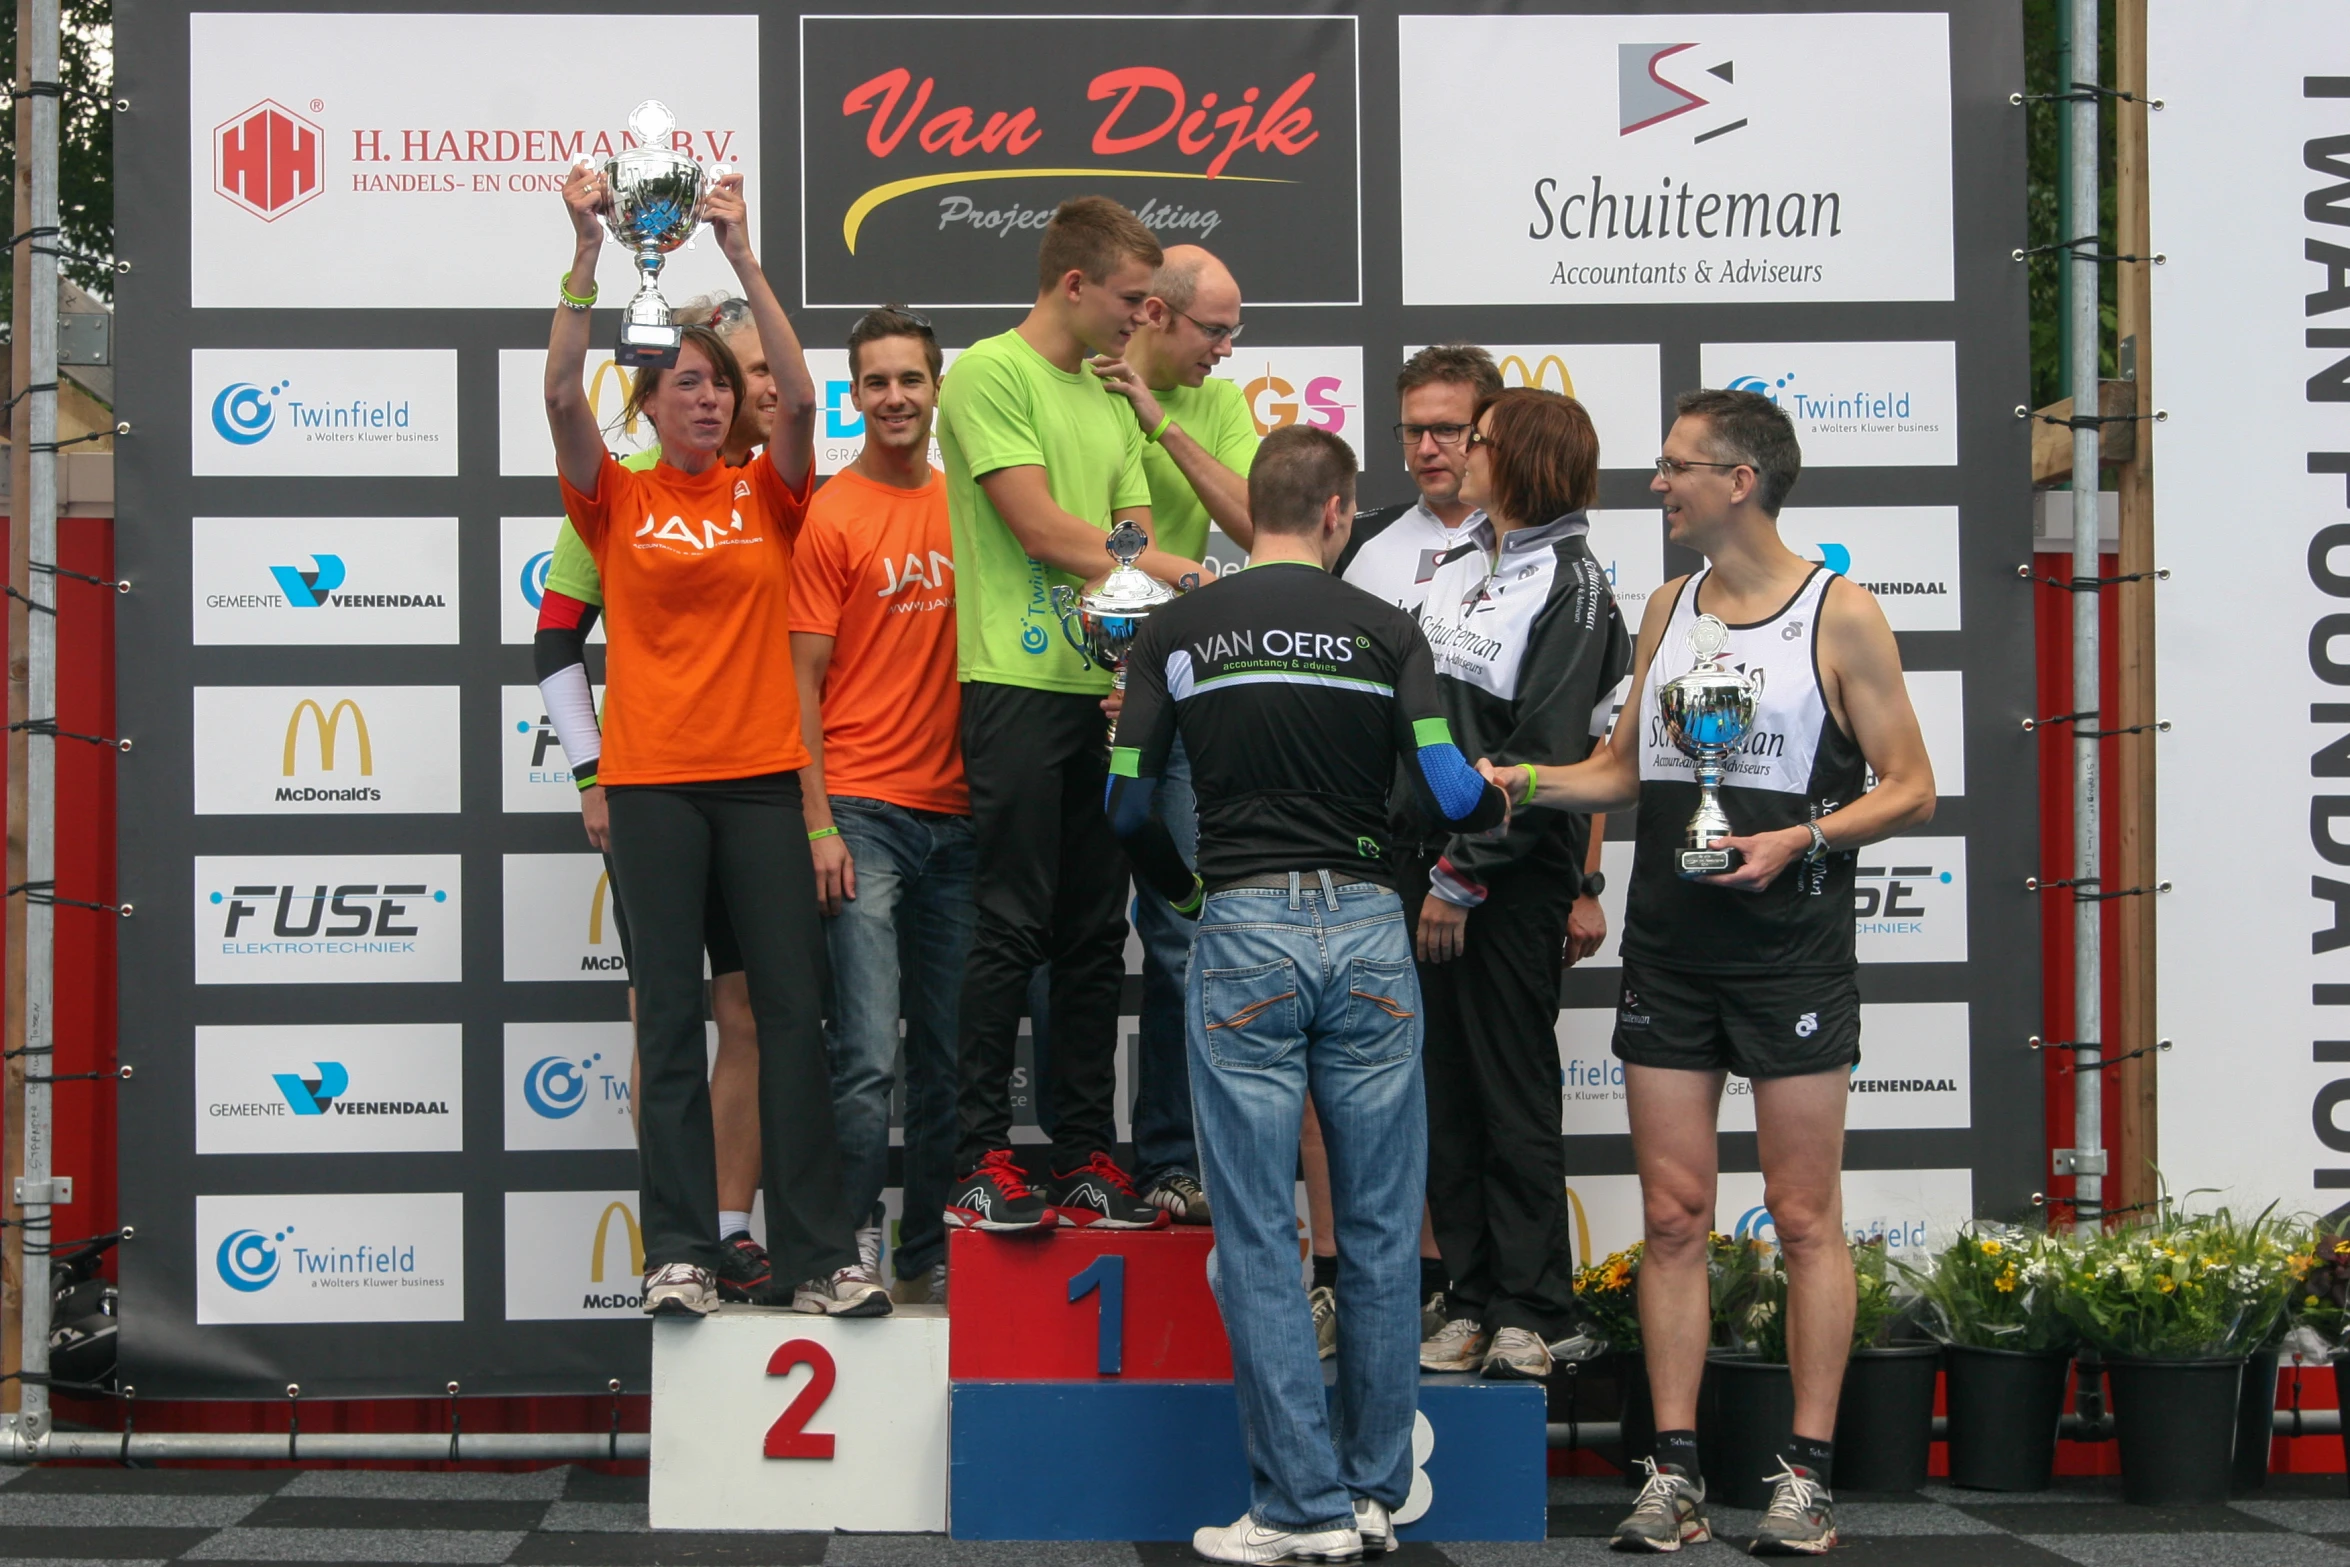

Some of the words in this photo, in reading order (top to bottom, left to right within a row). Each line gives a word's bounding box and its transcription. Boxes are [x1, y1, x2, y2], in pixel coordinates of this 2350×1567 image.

[843, 67, 1042, 157] Van
[1088, 66, 1319, 179] Dijk
[352, 130, 391, 162] H.
[352, 174, 465, 192] HANDELS-
[472, 174, 503, 192] EN
[1528, 175, 1842, 240] Schuiteman
[1550, 261, 1687, 284] Accountants
[1695, 260, 1712, 283] &
[1719, 259, 1823, 283] Adviseurs
[288, 400, 409, 428] Twinfield
[1794, 392, 1909, 419] Twinfield
[306, 434, 313, 442] a
[315, 432, 355, 442] Wolters
[358, 432, 393, 442] Kluwer
[396, 431, 439, 442] business
[1811, 425, 1817, 433] a
[1820, 423, 1858, 433] Wolters
[1860, 423, 1894, 433] Kluwer
[1897, 422, 1939, 432] business
[206, 595, 282, 608] GEMEENTE
[331, 594, 446, 608] VEENENDAAL
[1194, 629, 1254, 664] VAN
[1262, 629, 1353, 662] OERS
[1223, 658, 1288, 671] accountancy
[1291, 658, 1299, 668] &
[1303, 662, 1337, 672] advies
[275, 787, 381, 801] McDonald's
[224, 884, 427, 937] FUSE
[222, 942, 415, 954] ELEKTROTECHNIEK
[1576, 1091, 1609, 1100] Kluwer
[1849, 1080, 1957, 1093] VEENENDAAL
[209, 1103, 285, 1117] GEMEENTE
[334, 1102, 449, 1115] VEENENDAAL
[293, 1246, 414, 1273] Twinfield
[320, 1278, 359, 1287] Wolters
[363, 1278, 398, 1287] Kluwer
[401, 1277, 445, 1287] business
[1068, 1254, 1124, 1374] 1
[763, 1338, 836, 1459] 2
